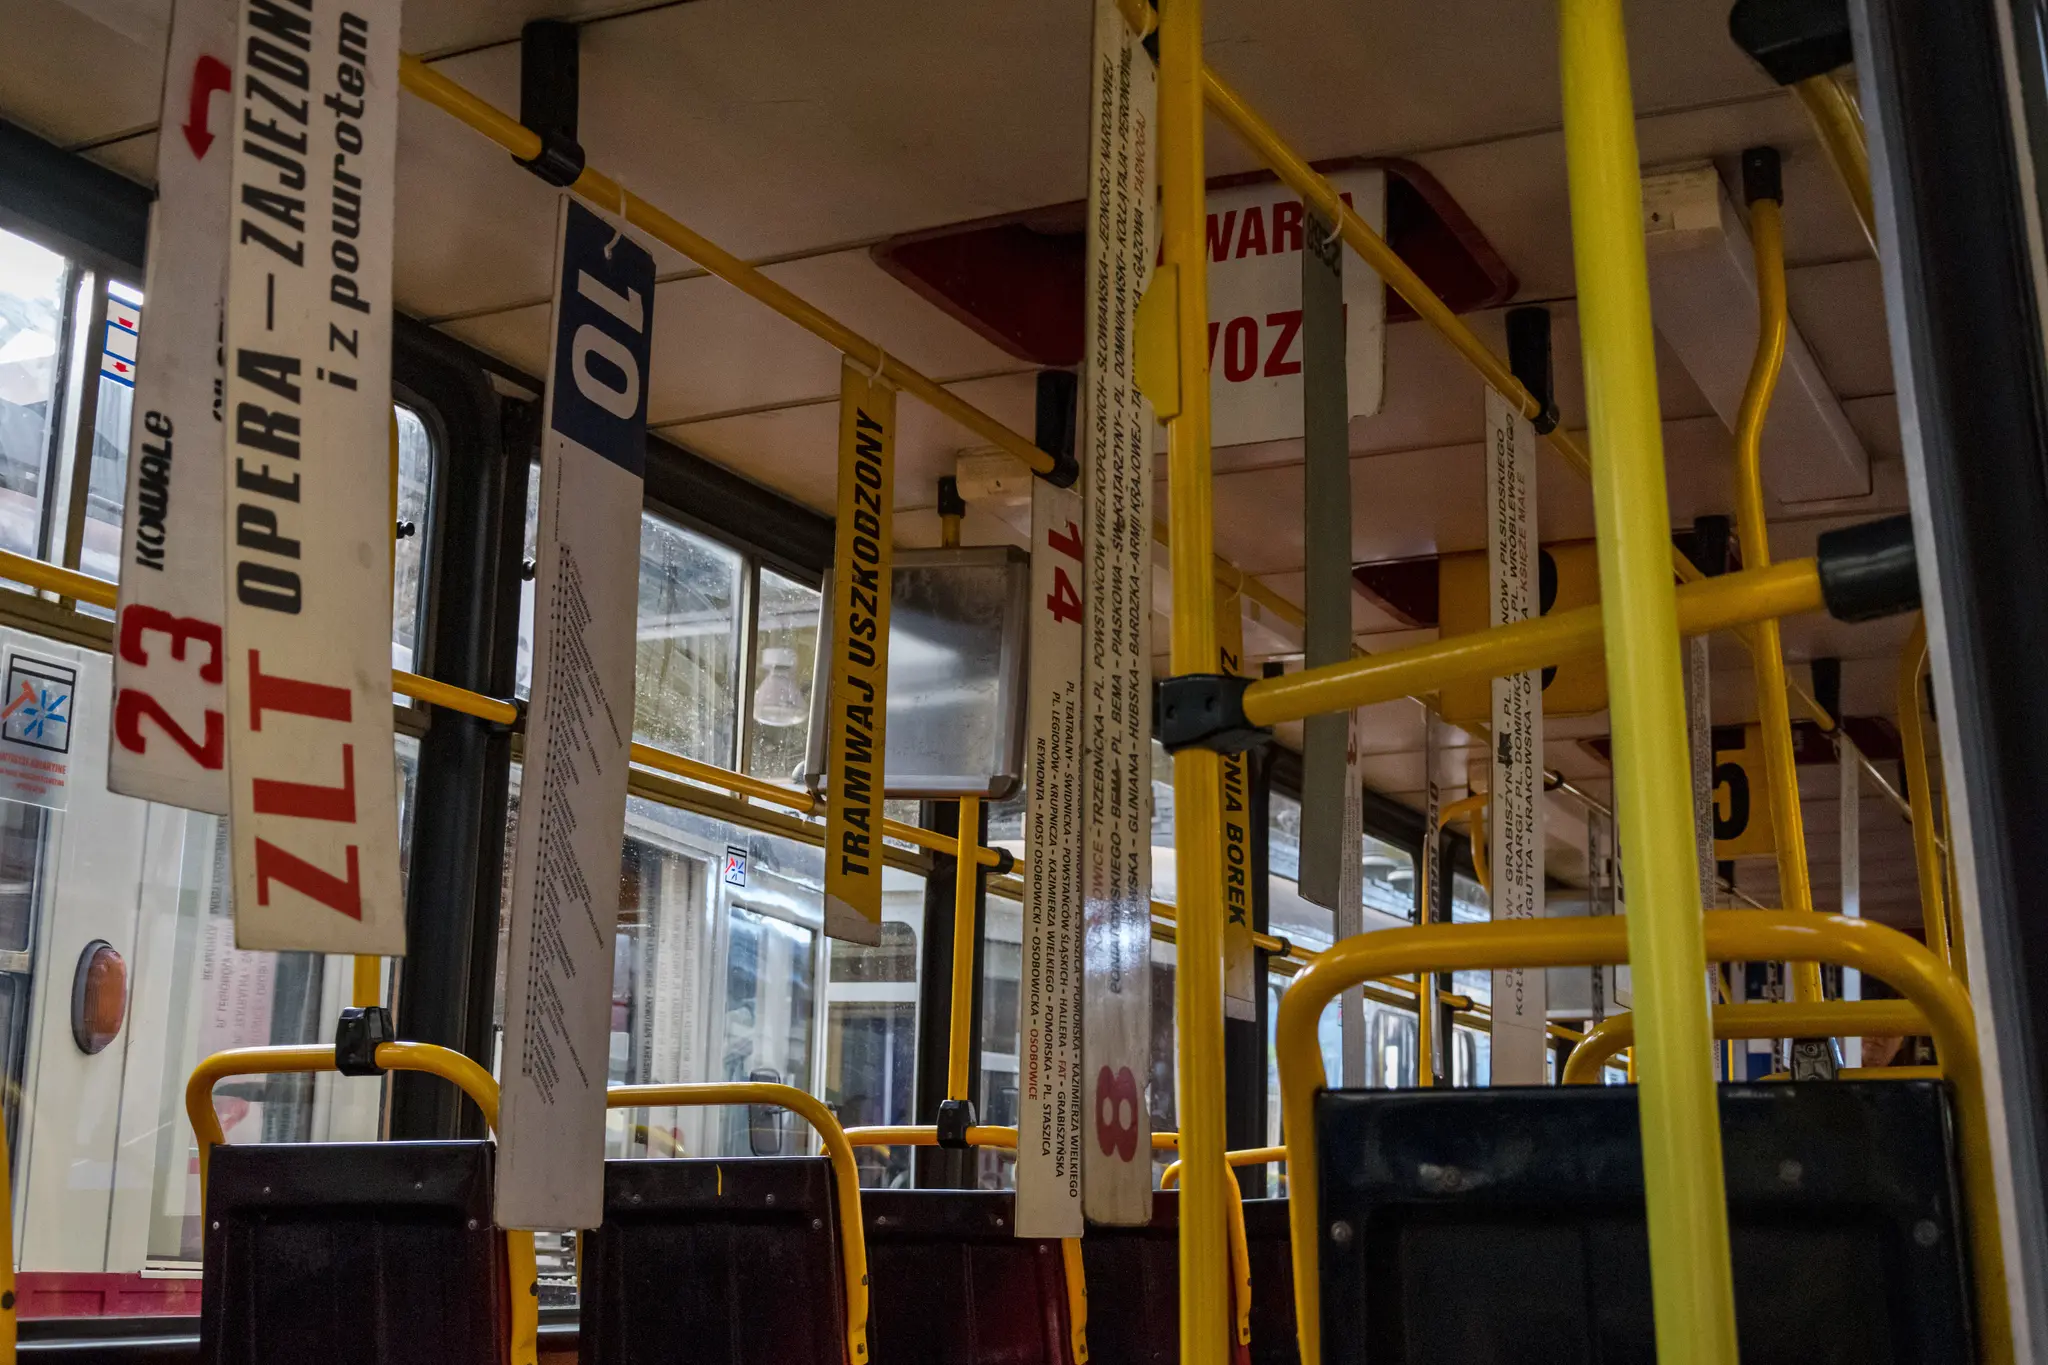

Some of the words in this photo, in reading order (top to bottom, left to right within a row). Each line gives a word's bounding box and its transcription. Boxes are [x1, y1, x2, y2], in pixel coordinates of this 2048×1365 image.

[239, 0, 312, 268] ZAJEZDN
[1100, 54, 1113, 166] NARODOWEJ
[322, 11, 370, 316] powrotem
[1134, 107, 1146, 198] TARNOGAJ
[1097, 166, 1111, 250] JEDNOŚCI
[316, 366, 358, 392] i
[329, 321, 358, 360] z
[571, 269, 644, 420] 10
[235, 348, 302, 616] OPERA
[1094, 383, 1107, 537] WIELKOPOLSKICH
[1130, 419, 1143, 511] KRAJOWEJ
[1497, 428, 1508, 566] PIŁSUDSKIEGO
[1516, 471, 1526, 523] MAŁE
[848, 406, 884, 668] USZKODZONY
[1047, 521, 1083, 625] 14
[1111, 565, 1123, 657] PIASKOWA
[1128, 575, 1140, 657] BARDZKA
[114, 604, 224, 770] 23
[1051, 691, 1061, 708] PL.
[1065, 680, 1074, 697] PL.
[1111, 674, 1123, 725] BEMA
[1127, 669, 1141, 741] HUBSKA
[1036, 737, 1046, 801] REYMONTA
[1050, 711, 1062, 772] LEGIONÓW
[1065, 700, 1075, 763] TEATRALNY
[247, 648, 362, 922] ZLT
[841, 675, 874, 877] TRAMWAJ
[1063, 772, 1073, 836] ŚWIDNICKA
[1127, 753, 1139, 834] GLINIANA
[1523, 710, 1533, 833] KRAKOWSKA
[1034, 812, 1044, 848] MOST
[1049, 784, 1059, 846] KRUPNICZA
[1514, 810, 1525, 888] SKARGI
[1033, 850, 1043, 925] OSOBOWICKI
[1047, 858, 1057, 927] KAZIMIERZA
[1060, 847, 1072, 927] POWSTAŃCÓW
[1226, 822, 1246, 928] BOREK
[1030, 935, 1042, 1016] OSOBOWICKA
[1045, 930, 1056, 994] WIELKIEGO
[1059, 933, 1071, 986] ŚLĄSKICH
[1043, 1004, 1054, 1071] POMORSKA
[1058, 998, 1067, 1047] HALLERA
[1028, 1028, 1039, 1101] OSOBOWICE
[1042, 1083, 1052, 1100] PL.
[1057, 1059, 1066, 1078] FAT
[1041, 1103, 1052, 1157] STASZICA
[1055, 1091, 1066, 1178] GRABISZYŃSKA
[1095, 1065, 1138, 1163] 8
[1068, 1135, 1079, 1198] WIELKIEGO
